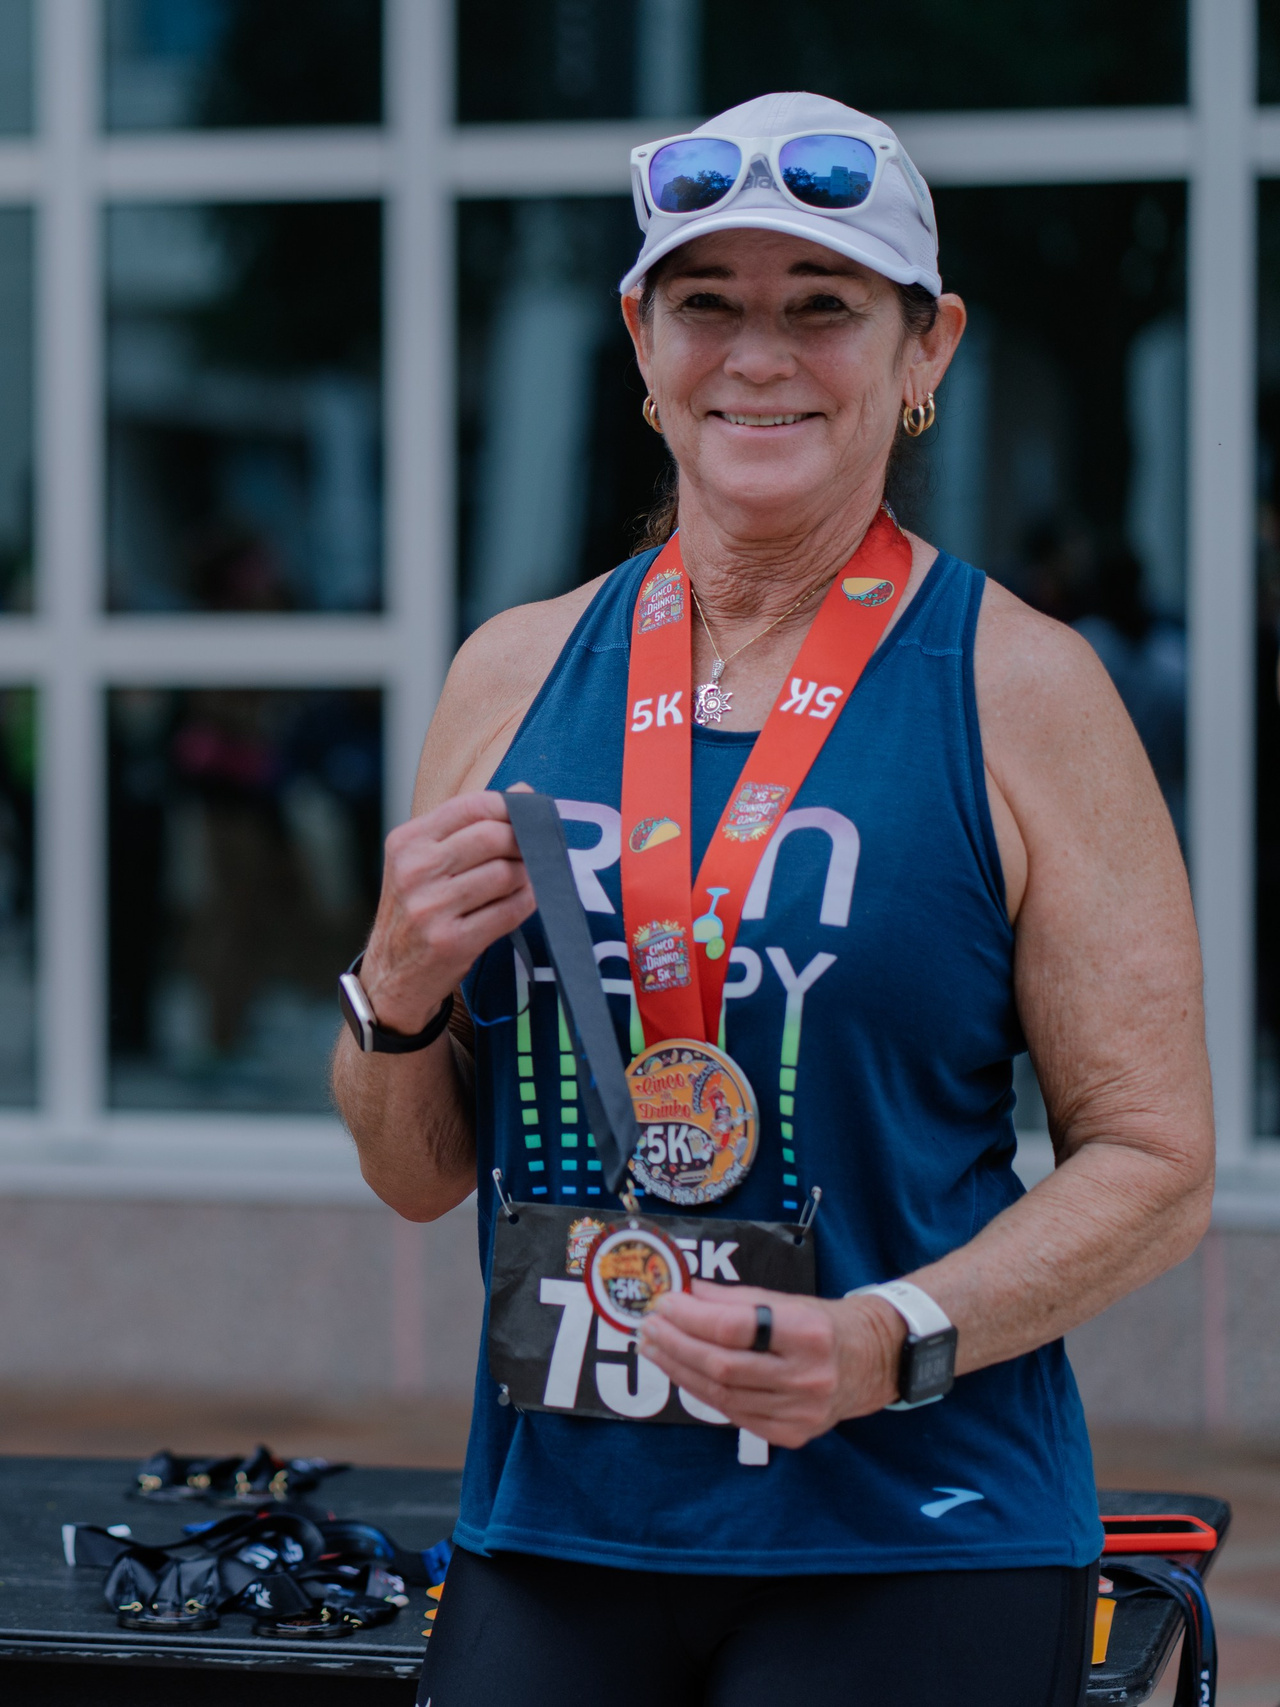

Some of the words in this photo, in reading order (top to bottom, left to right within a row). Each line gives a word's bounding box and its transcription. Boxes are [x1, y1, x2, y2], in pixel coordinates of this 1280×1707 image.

[651, 584, 672, 602] CINCO
[647, 595, 675, 615] DRINKO
[655, 610, 666, 622] 5K
[779, 677, 844, 720] 5K
[631, 690, 683, 732] 5K
[649, 938, 674, 956] CINCO
[657, 968, 671, 982] 5K
[635, 1072, 686, 1096] Cinco
[638, 1099, 692, 1120] Drinko
[646, 1124, 692, 1164] 5K
[615, 1278, 641, 1300] 5K
[540, 1278, 731, 1424] 75
